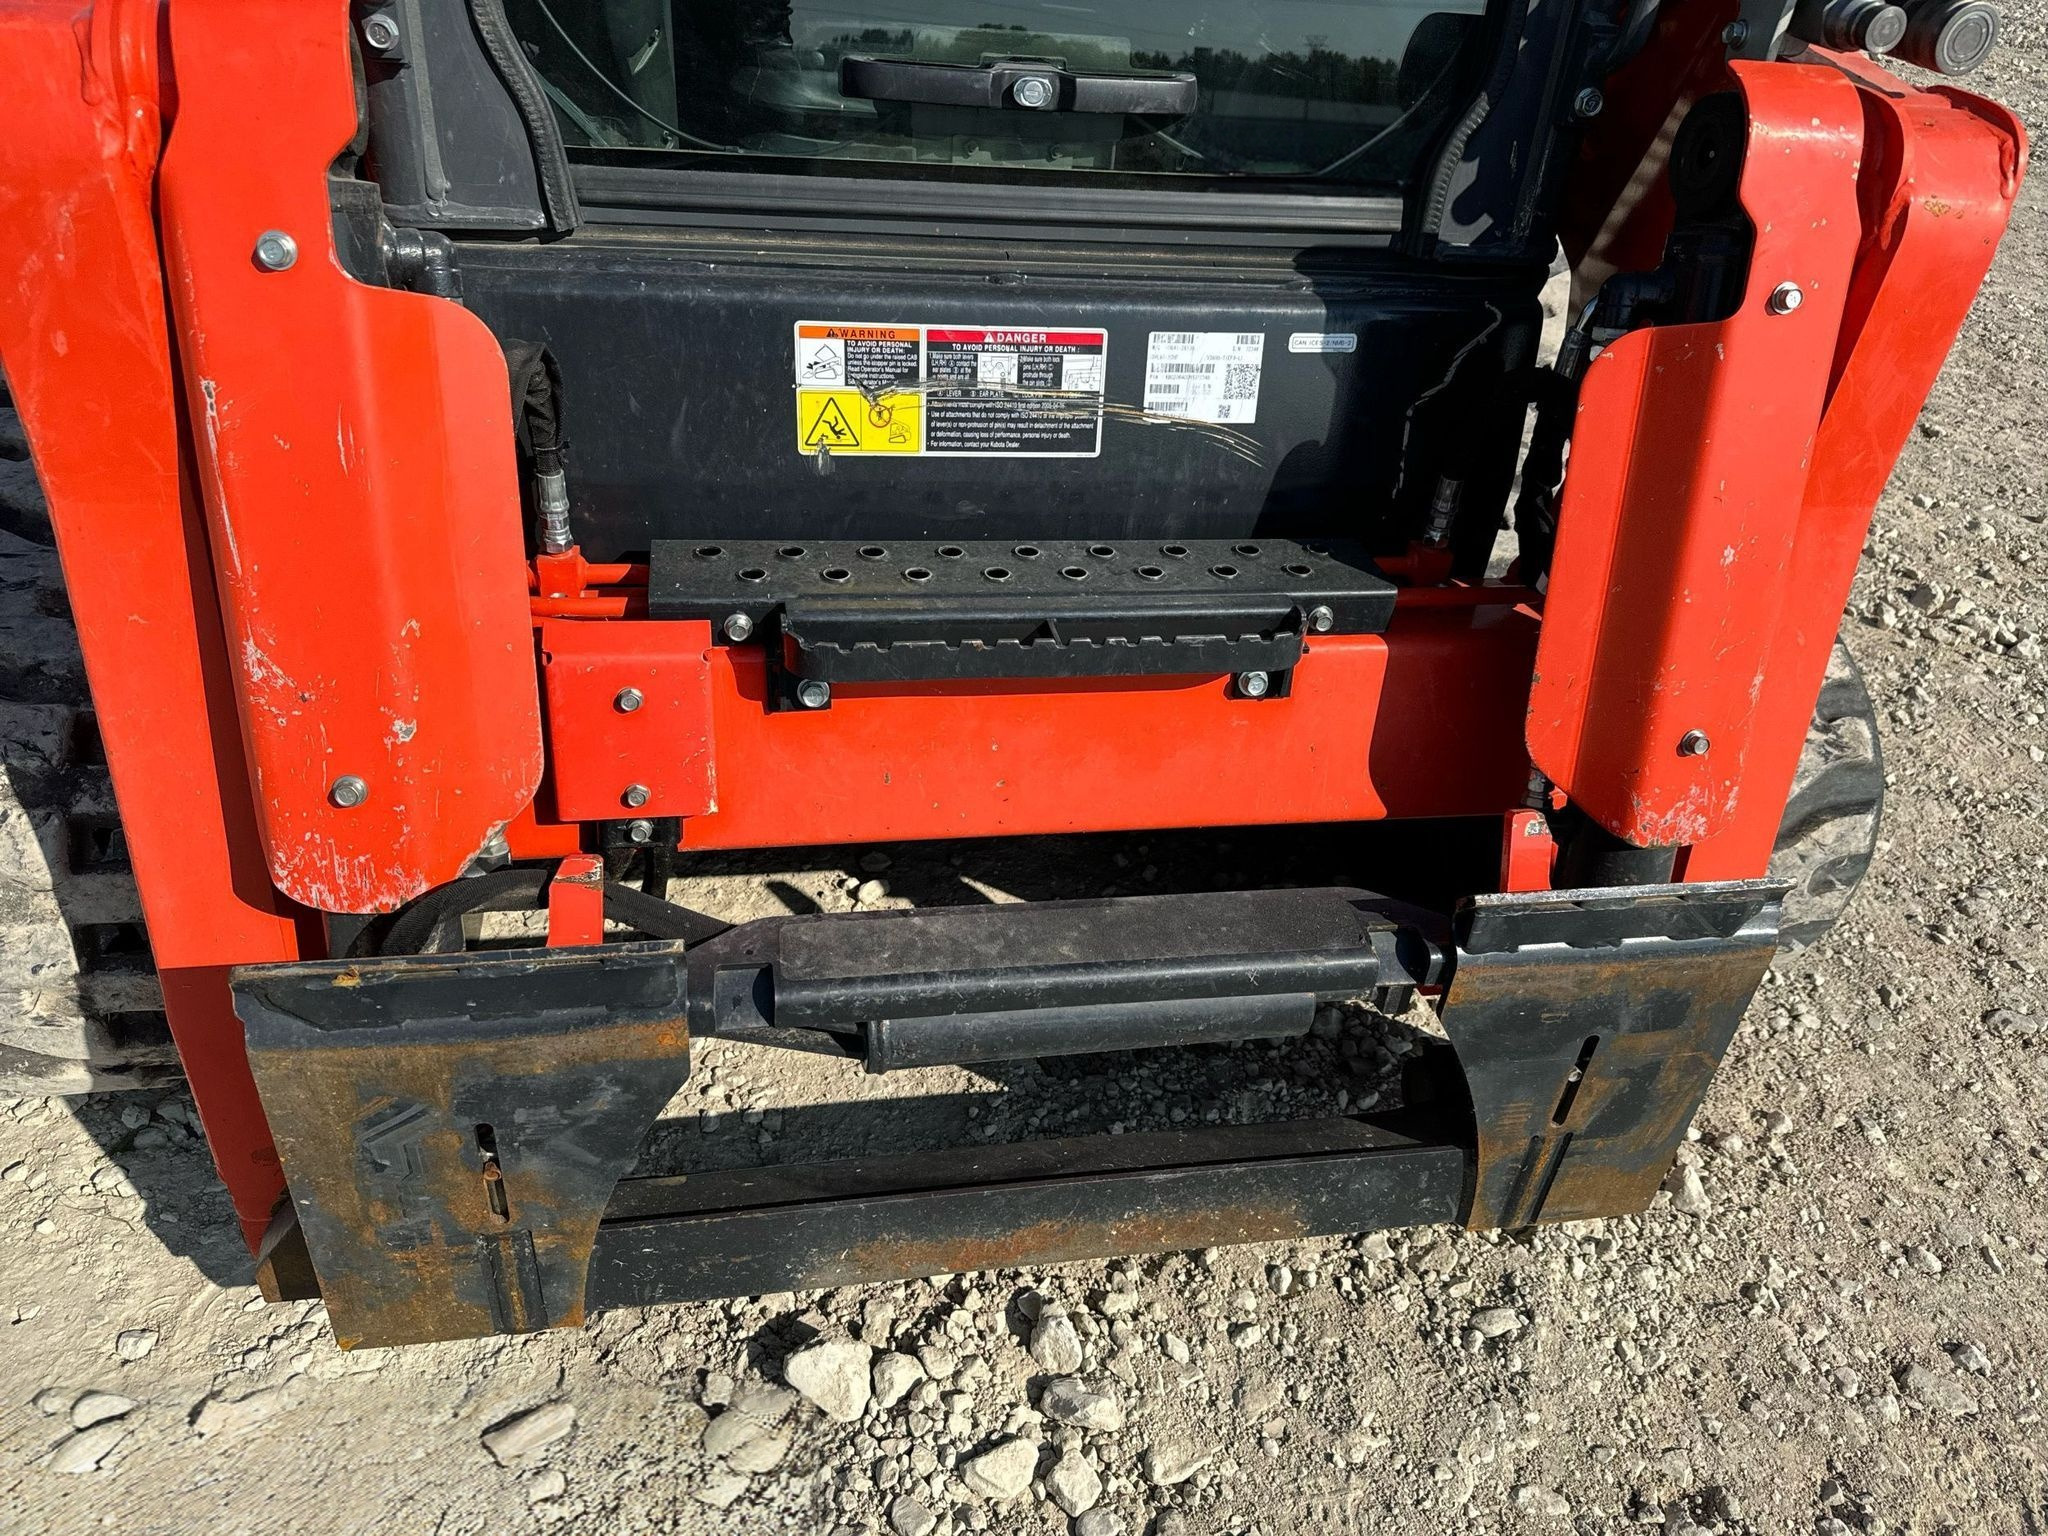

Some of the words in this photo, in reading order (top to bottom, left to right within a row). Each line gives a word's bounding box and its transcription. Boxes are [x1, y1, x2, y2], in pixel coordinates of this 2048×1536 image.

[840, 329, 896, 339] WARNING
[997, 332, 1047, 342] DANGER
[952, 343, 961, 351] TO
[984, 344, 1018, 352] PERSONAL
[979, 390, 990, 398] EAR
[990, 390, 1004, 398] PLATE
[995, 412, 1011, 420] comply
[1020, 411, 1028, 419] ISO
[958, 421, 989, 429] non-protrusion
[1071, 422, 1094, 430] attachment
[963, 431, 979, 440] causing
[994, 431, 1021, 440] performance,
[1022, 432, 1041, 440] personal
[1041, 432, 1053, 440] injury
[939, 440, 964, 448] information,
[1005, 441, 1021, 449] Dealer.
